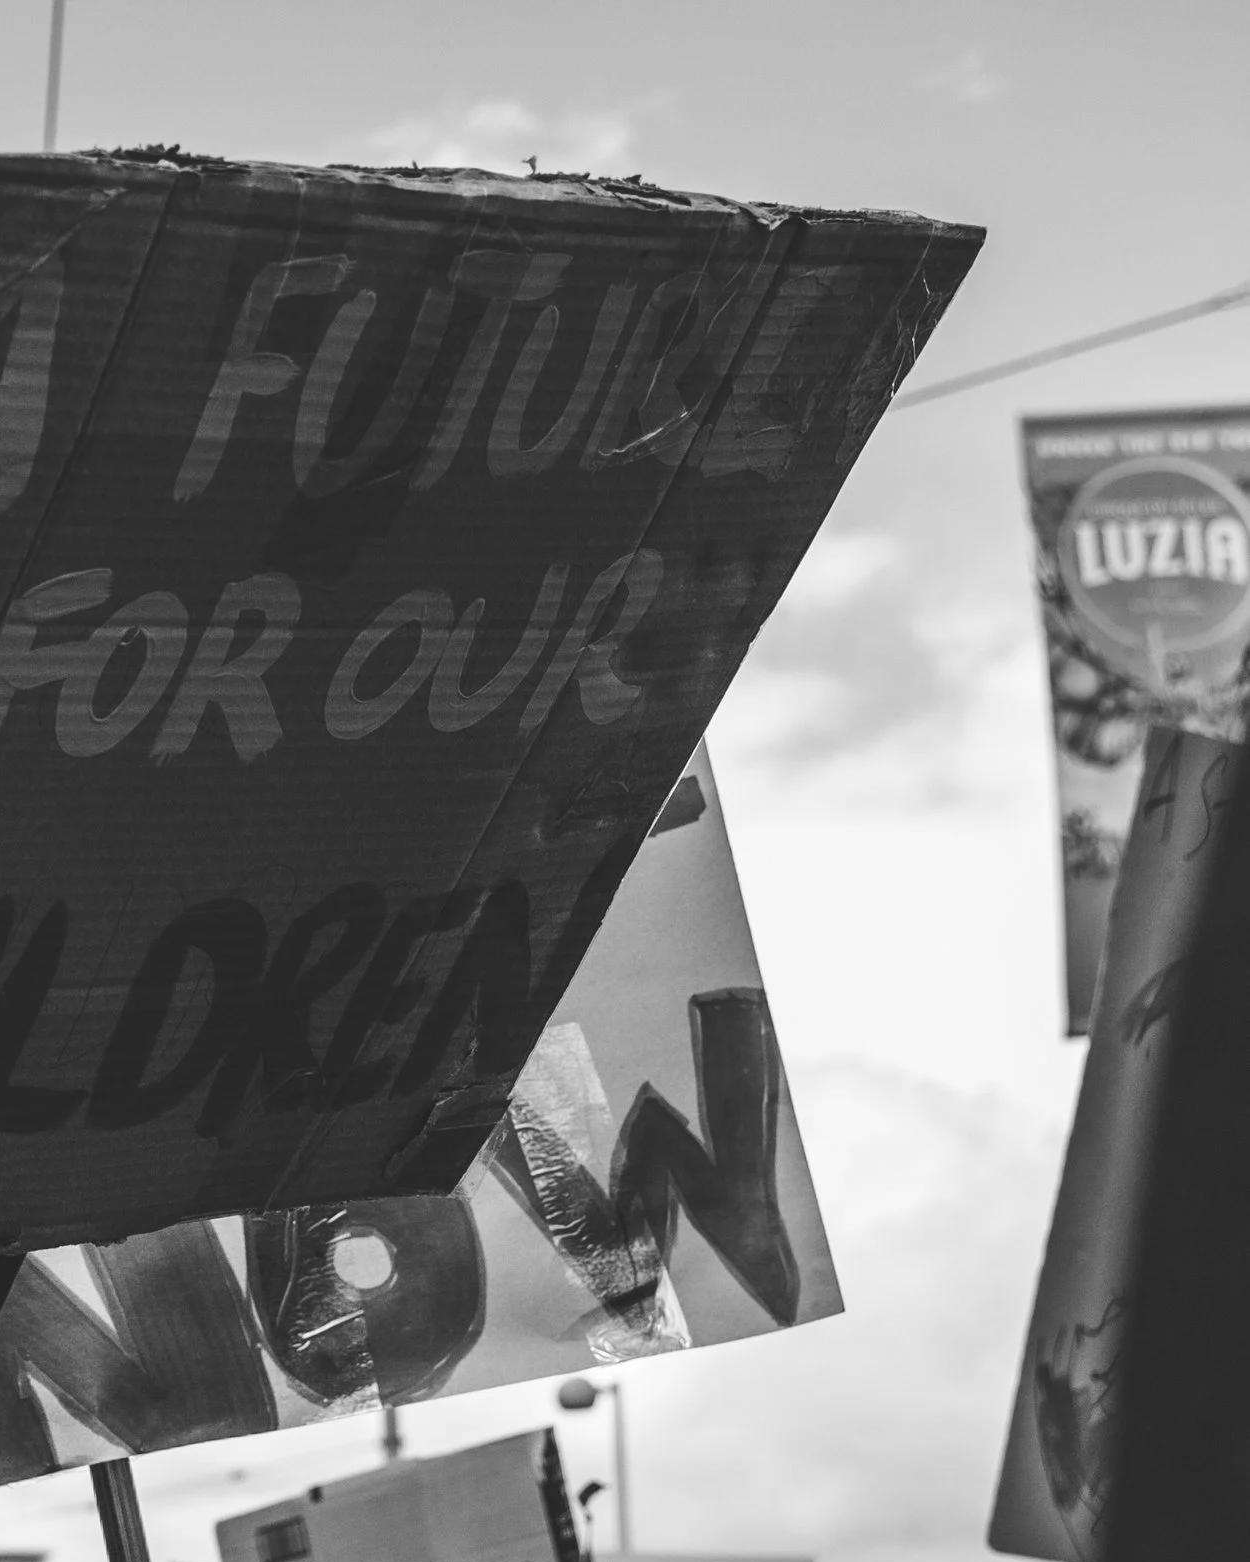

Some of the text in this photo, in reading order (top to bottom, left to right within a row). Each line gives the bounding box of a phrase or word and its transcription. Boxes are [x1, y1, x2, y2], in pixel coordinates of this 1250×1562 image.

[172, 250, 865, 502] FUTURE
[325, 548, 664, 741] OUR
[1073, 516, 1249, 588] LUZIA
